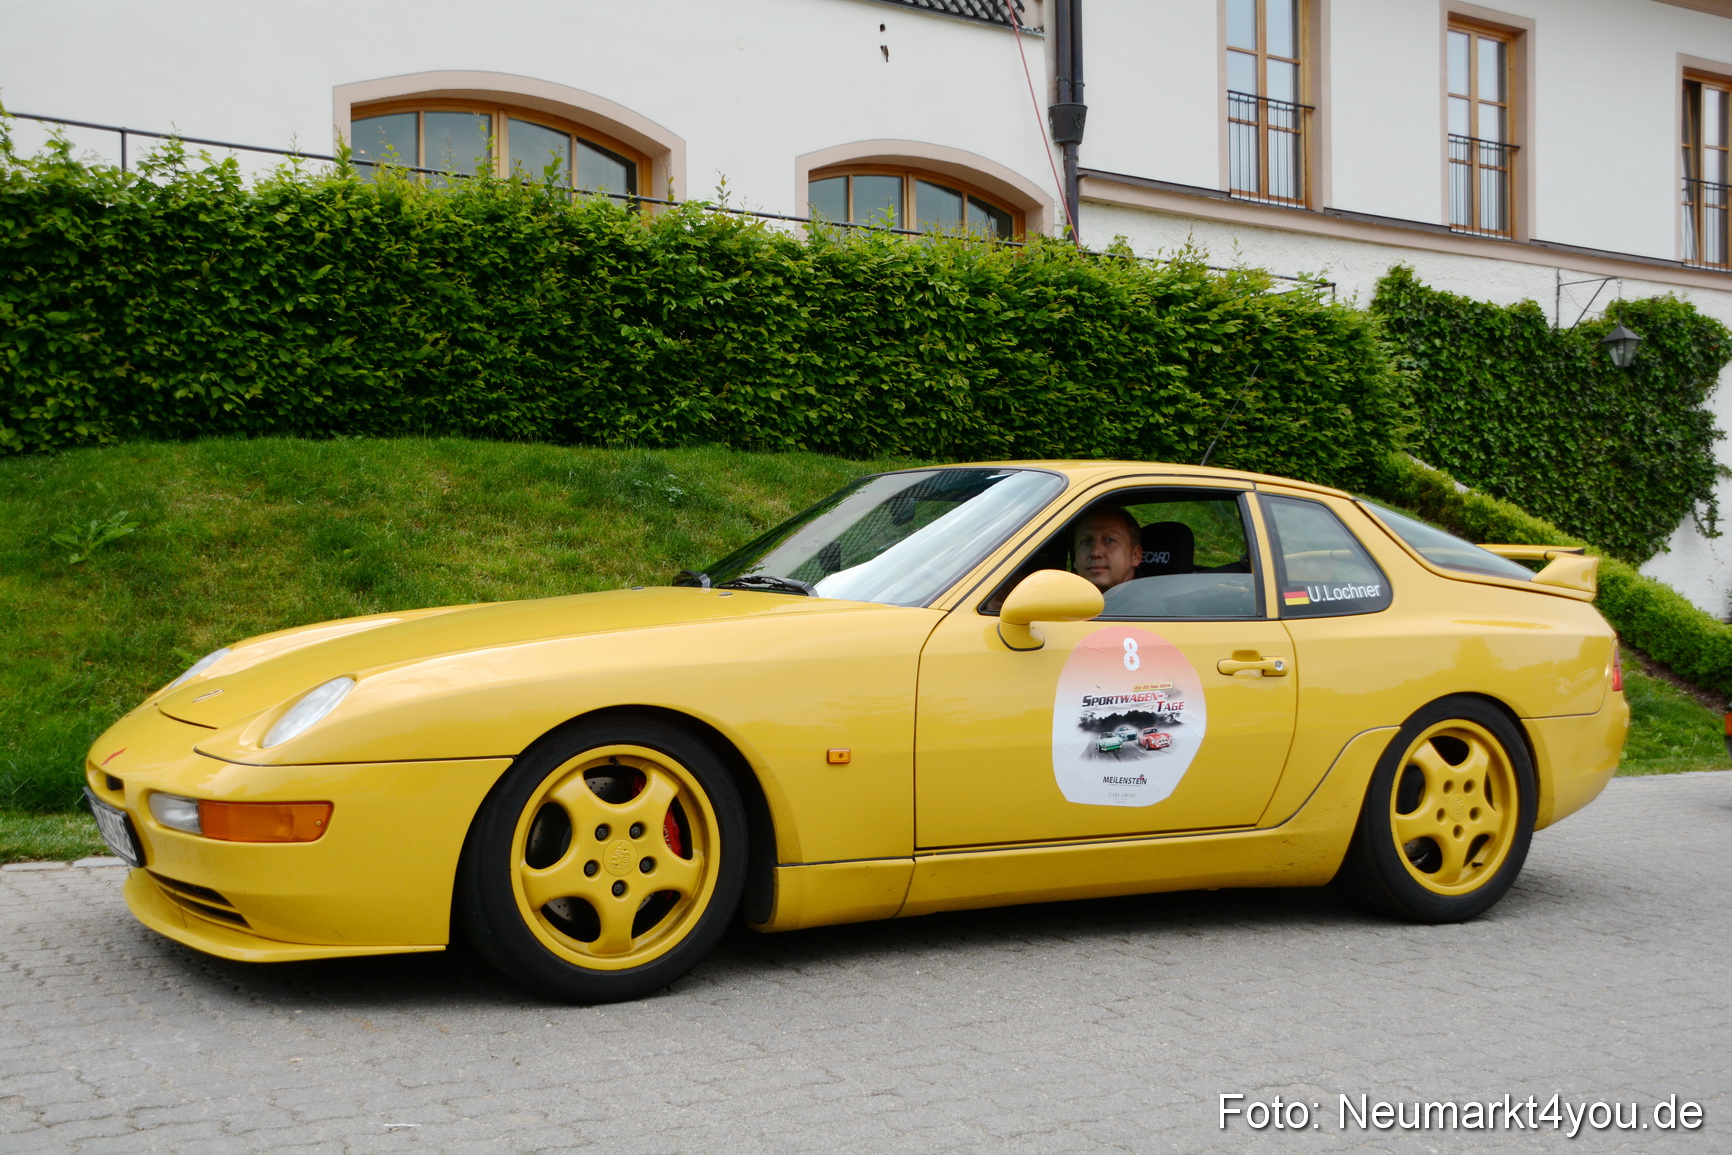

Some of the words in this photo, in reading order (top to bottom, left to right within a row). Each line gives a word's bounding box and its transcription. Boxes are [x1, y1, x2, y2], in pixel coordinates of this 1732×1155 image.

[1142, 551, 1170, 564] ECARO
[1307, 584, 1380, 602] U.Lochner
[1123, 637, 1140, 671] 8
[1082, 692, 1163, 707] SPORTWAGEN-
[1156, 701, 1185, 712] TAGE
